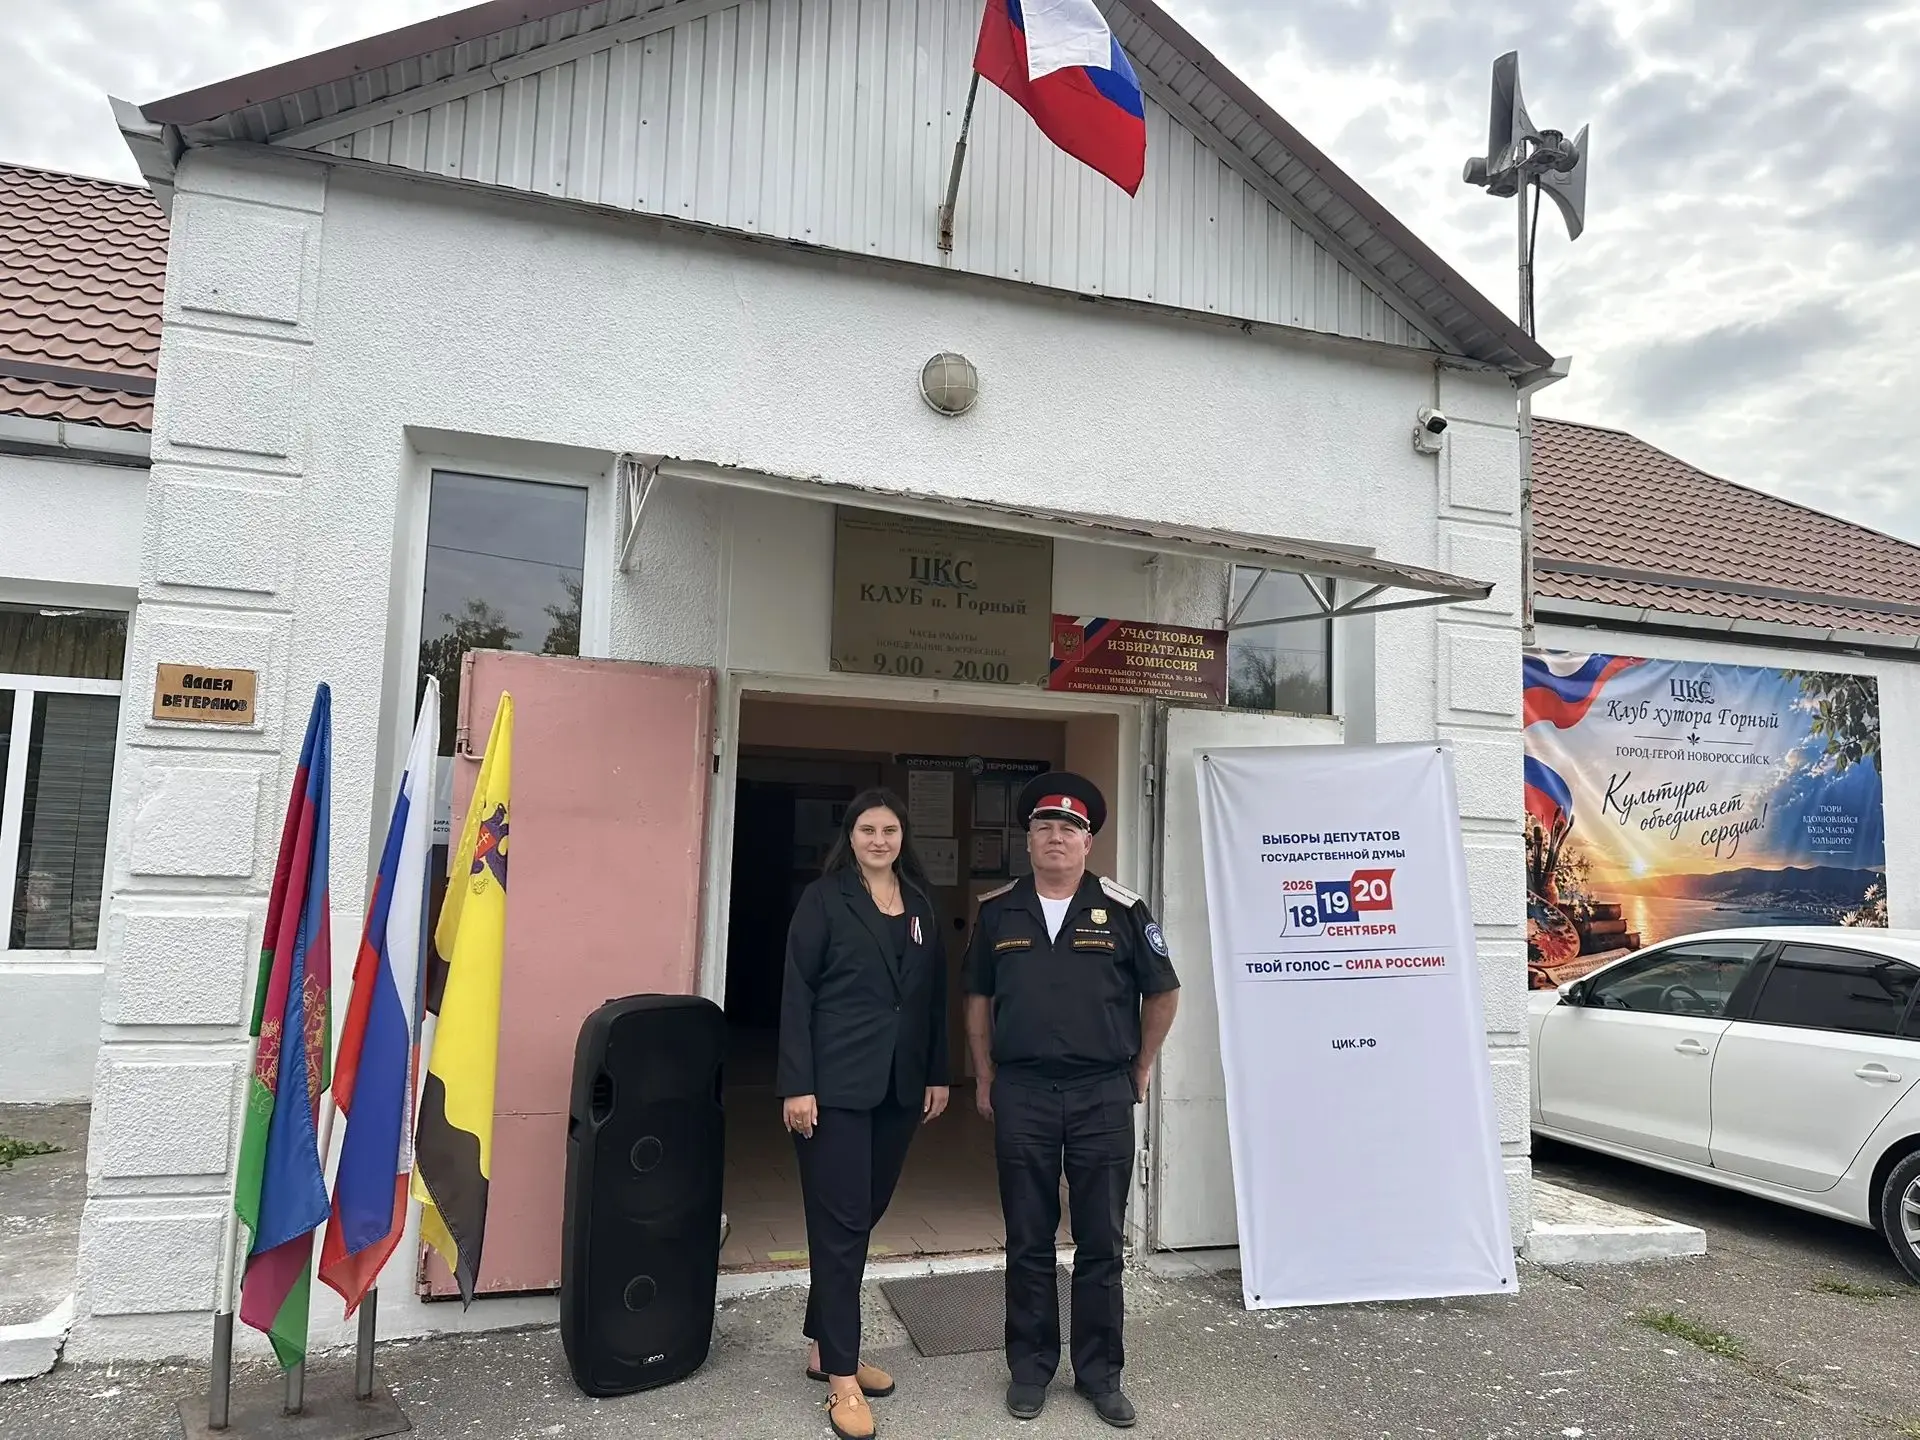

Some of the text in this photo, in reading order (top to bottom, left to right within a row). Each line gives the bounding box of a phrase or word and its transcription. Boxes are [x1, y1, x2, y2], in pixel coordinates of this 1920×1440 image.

[909, 556, 973, 584] ЦКС
[859, 583, 923, 606] КЛУБ
[956, 592, 1028, 616] Горный
[1120, 627, 1204, 645] УЧАСТКОВАЯ
[1107, 640, 1215, 660] ИЗБИРАТЕЛЬНАЯ
[873, 652, 924, 676] 9.00
[952, 660, 1009, 682] 20.00
[1126, 656, 1198, 671] КОМИССИЯ
[1074, 667, 1141, 677] ИЗБИРАТЕЛЬНОГО
[1143, 672, 1175, 681] УЧАСТКА
[1669, 678, 1711, 700] ЦКС
[162, 694, 248, 711] ВЕТЕРАНОВ
[1607, 700, 1779, 732] Клуб хутора Горный
[1616, 747, 1770, 765] ГОРОД-ГЕРОЙ НОВОРОССИЙСК
[1602, 771, 1709, 825] Культура
[1640, 794, 1745, 840] объединяет
[1262, 831, 1400, 845] ВЫБОРЫ ДЕПУТАТОВ
[1701, 803, 1768, 859] сердца!
[1807, 826, 1825, 834] БУДЬ
[1261, 849, 1405, 863] ГОСУДАРСТВЕННОЙ ДУМЫ
[1282, 881, 1313, 890] 2026
[1289, 879, 1388, 927] 18 19 20
[1327, 925, 1396, 936] СЕНТЯБРЯ
[1246, 959, 1283, 973] ТВОЙ
[1286, 960, 1330, 972] ГОЛОС
[1346, 958, 1382, 970] СИЛА
[1386, 956, 1445, 968] РОССИИ!
[1331, 1038, 1377, 1050] ЦИК.РФ
